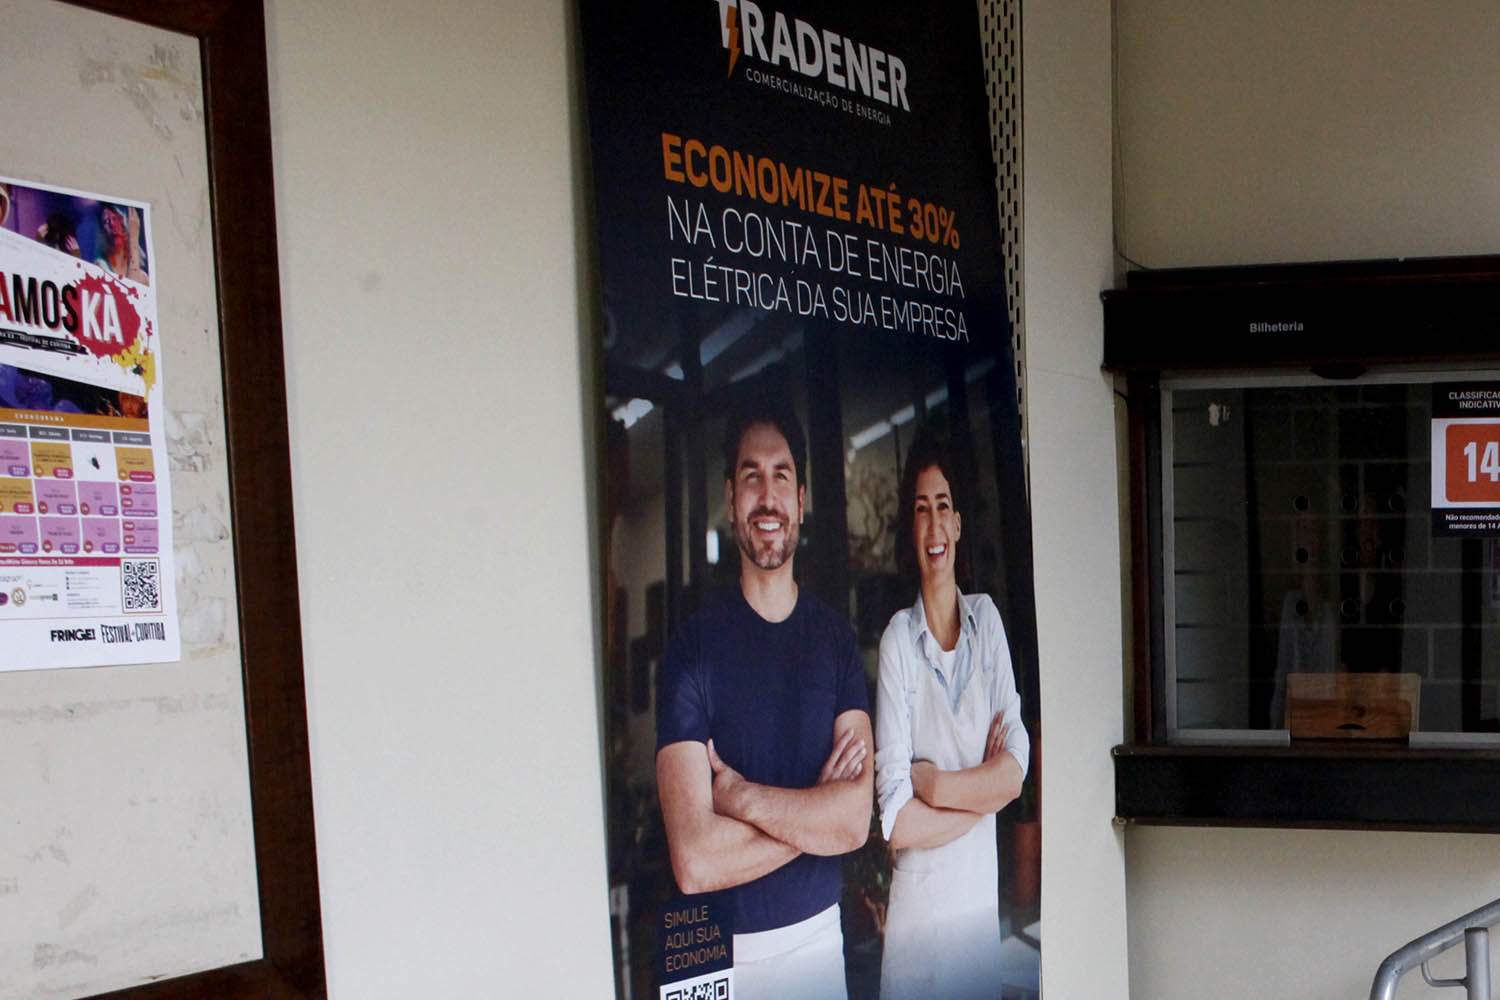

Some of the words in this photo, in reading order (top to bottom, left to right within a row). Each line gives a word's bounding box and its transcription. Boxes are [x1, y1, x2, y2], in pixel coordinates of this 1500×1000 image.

[714, 0, 911, 112] TRADENER
[746, 68, 838, 108] COMERCIALIZAÇÃO
[842, 98, 852, 113] DE
[857, 103, 892, 126] ENERGIA
[661, 132, 851, 221] ECONOMIZE
[856, 183, 905, 235] ATÉ
[909, 198, 961, 249] 30%
[667, 195, 716, 249] NA
[722, 208, 821, 269] CONTA
[827, 230, 862, 276] DE
[868, 240, 965, 299] ENERGIA
[671, 256, 792, 312] ELÉTRICA
[797, 280, 829, 319] DA
[833, 288, 878, 328] SUA
[882, 296, 969, 343] EMPRESA
[1249, 321, 1304, 333] Bilheteria
[50, 628, 96, 642] FRINGE!
[101, 624, 133, 643] FESTIVAL
[664, 905, 709, 929] SIMULE
[665, 930, 693, 951] AQUI
[696, 925, 721, 943] SUA
[665, 945, 728, 972] ECONOMIA
